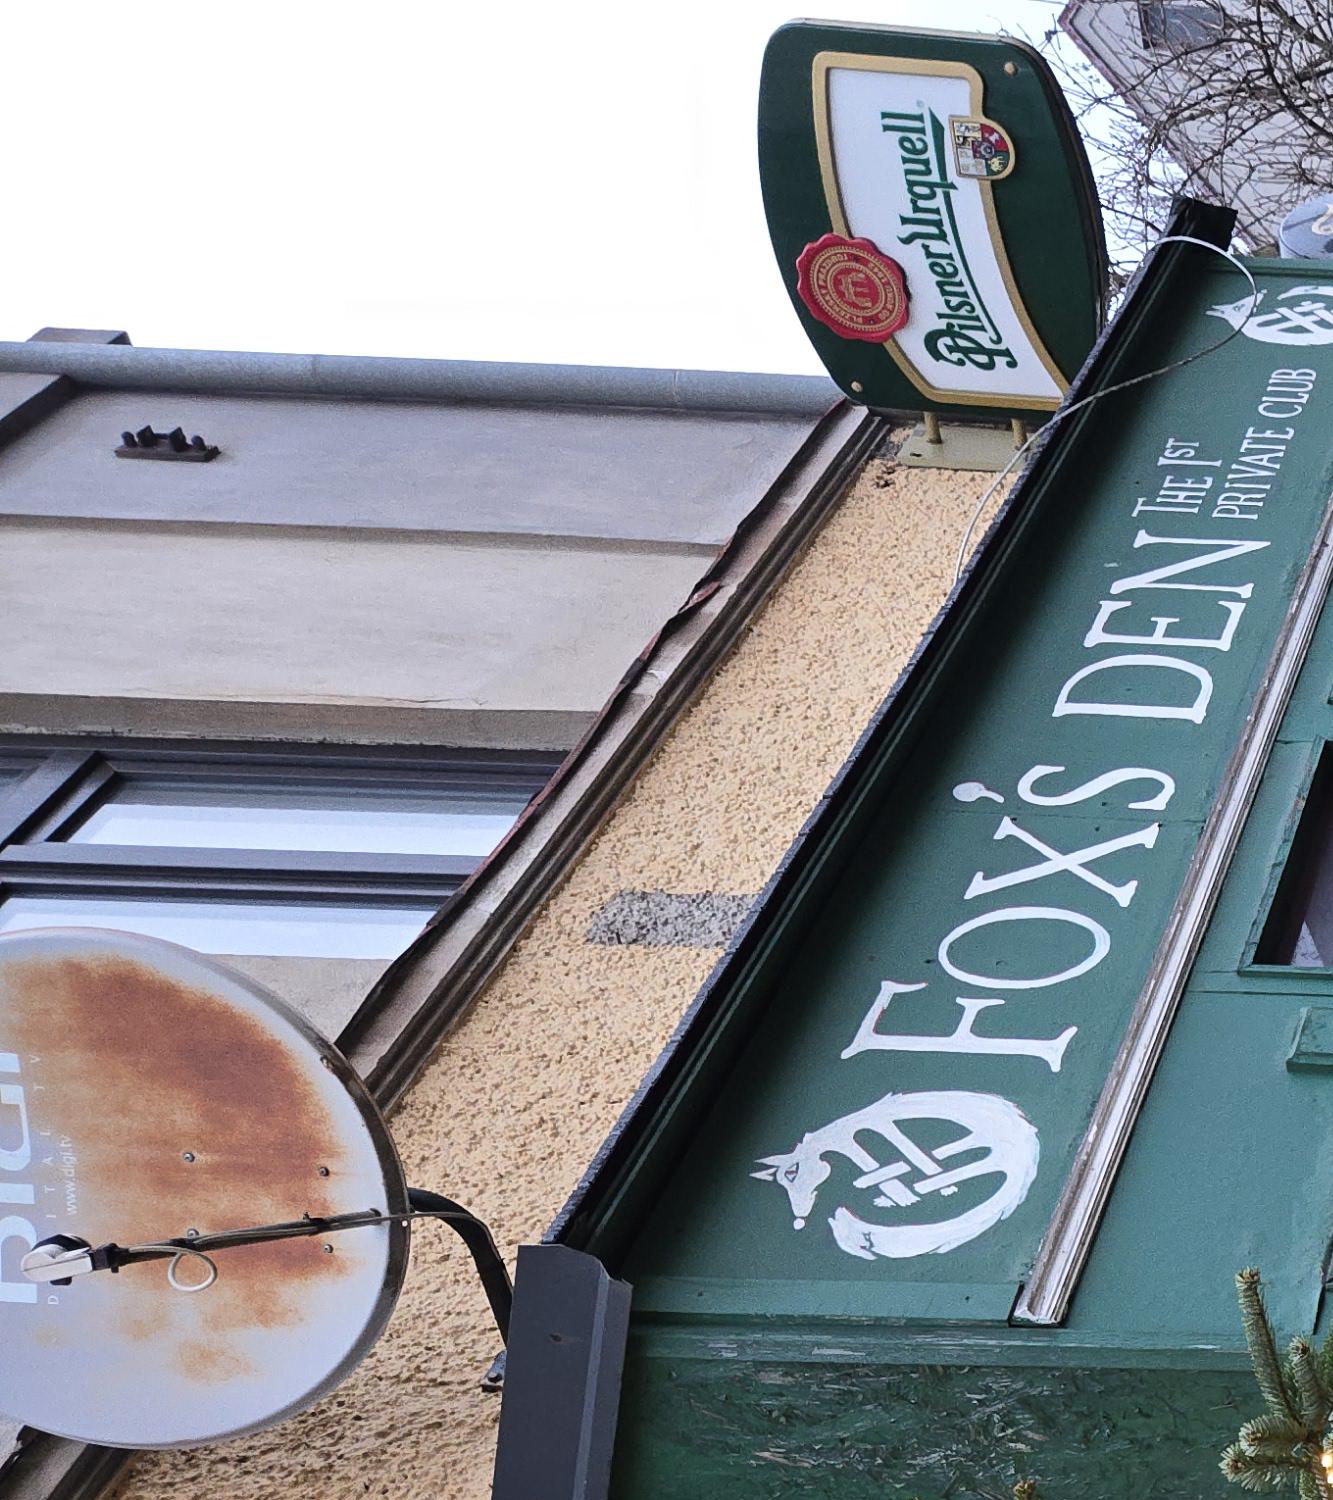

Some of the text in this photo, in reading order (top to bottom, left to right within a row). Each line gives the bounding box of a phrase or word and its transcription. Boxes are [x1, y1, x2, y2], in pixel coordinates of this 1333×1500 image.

[880, 110, 1019, 372] Pilsner Urquell
[1131, 475, 1213, 518] THE
[1211, 367, 1317, 521] PRIVATE CLUB
[840, 529, 1272, 1072] FOX'S DEN
[39, 1127, 60, 1305] DITAL
[60, 1133, 77, 1216] www.digi.tv
